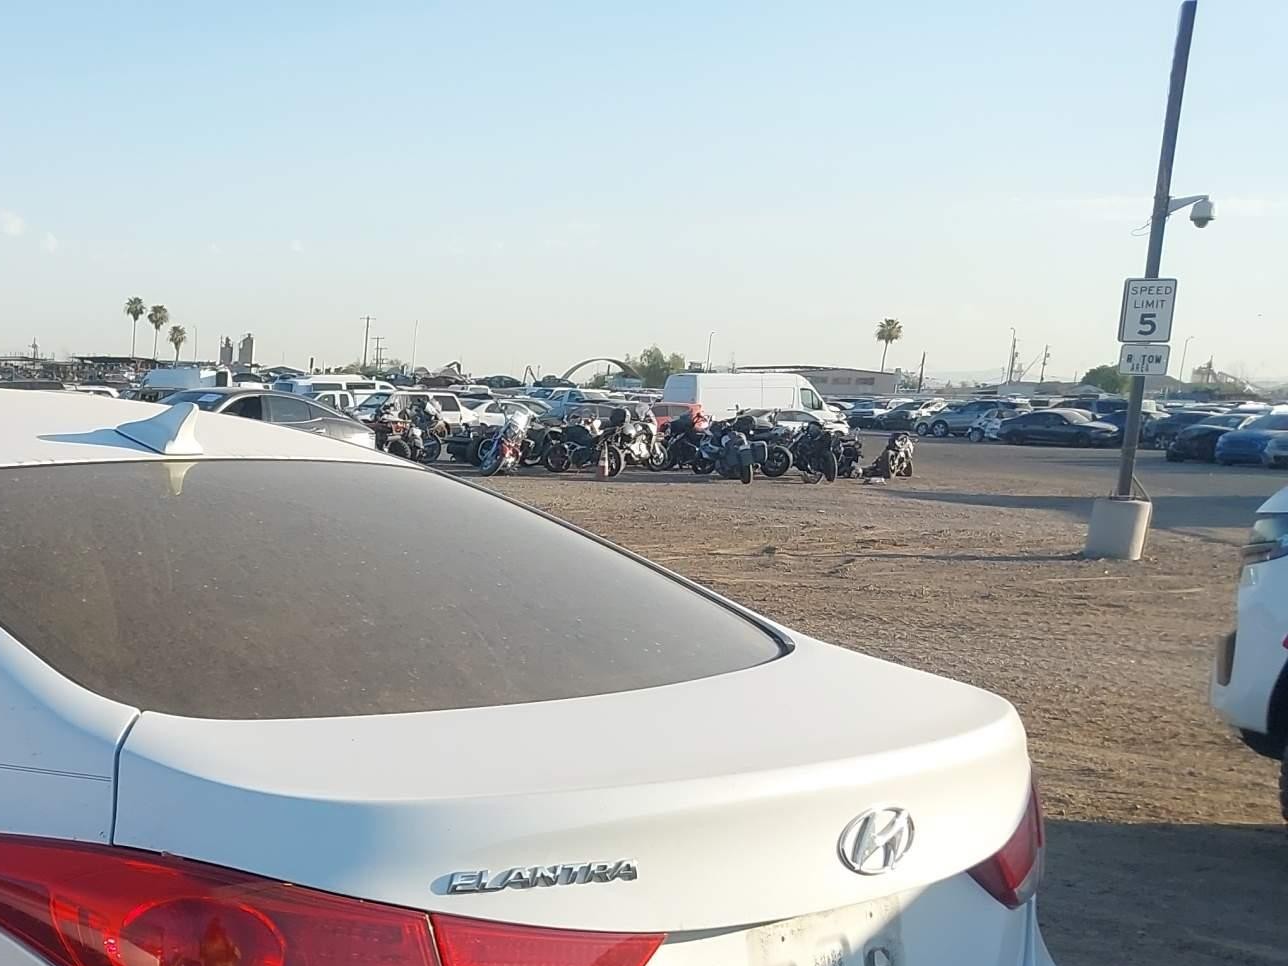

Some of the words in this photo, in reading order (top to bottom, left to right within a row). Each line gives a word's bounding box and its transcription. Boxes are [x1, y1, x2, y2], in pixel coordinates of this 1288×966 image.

[1130, 285, 1172, 296] SPEED
[1133, 299, 1167, 309] LIMIT
[1137, 312, 1157, 336] 5
[1141, 354, 1163, 365] TOW
[447, 858, 638, 894] ELANTRA
